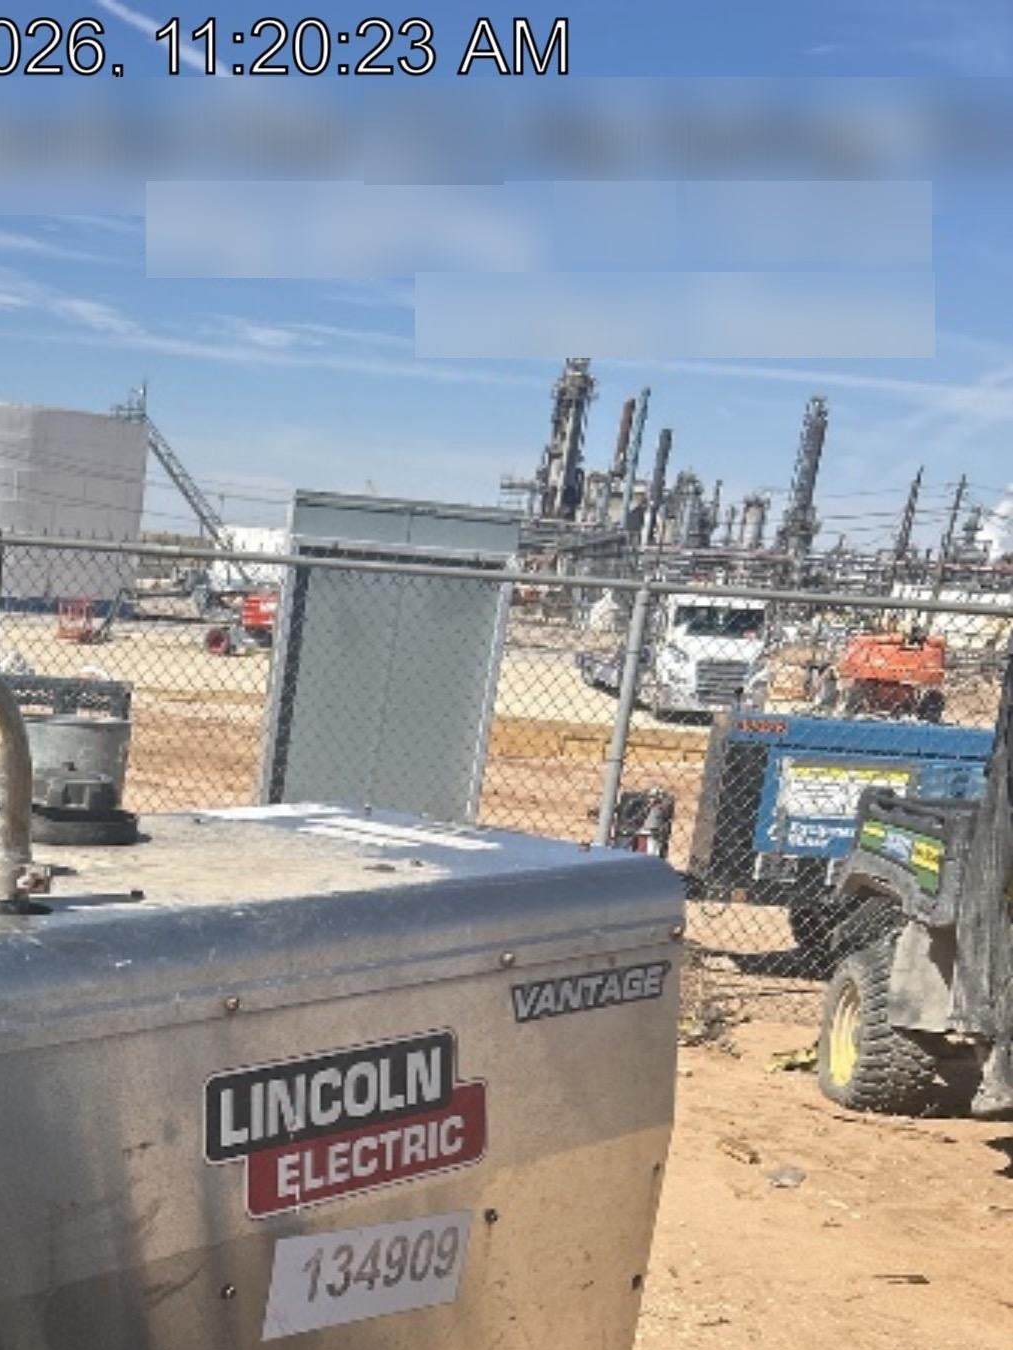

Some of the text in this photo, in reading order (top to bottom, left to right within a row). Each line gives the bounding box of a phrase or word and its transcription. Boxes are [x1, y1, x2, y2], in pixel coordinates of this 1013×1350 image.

[513, 966, 666, 1020] VANTAGE
[219, 1046, 442, 1148] LINCOLN
[277, 1114, 465, 1198] ELECTRIC
[303, 1225, 460, 1303] 134909
